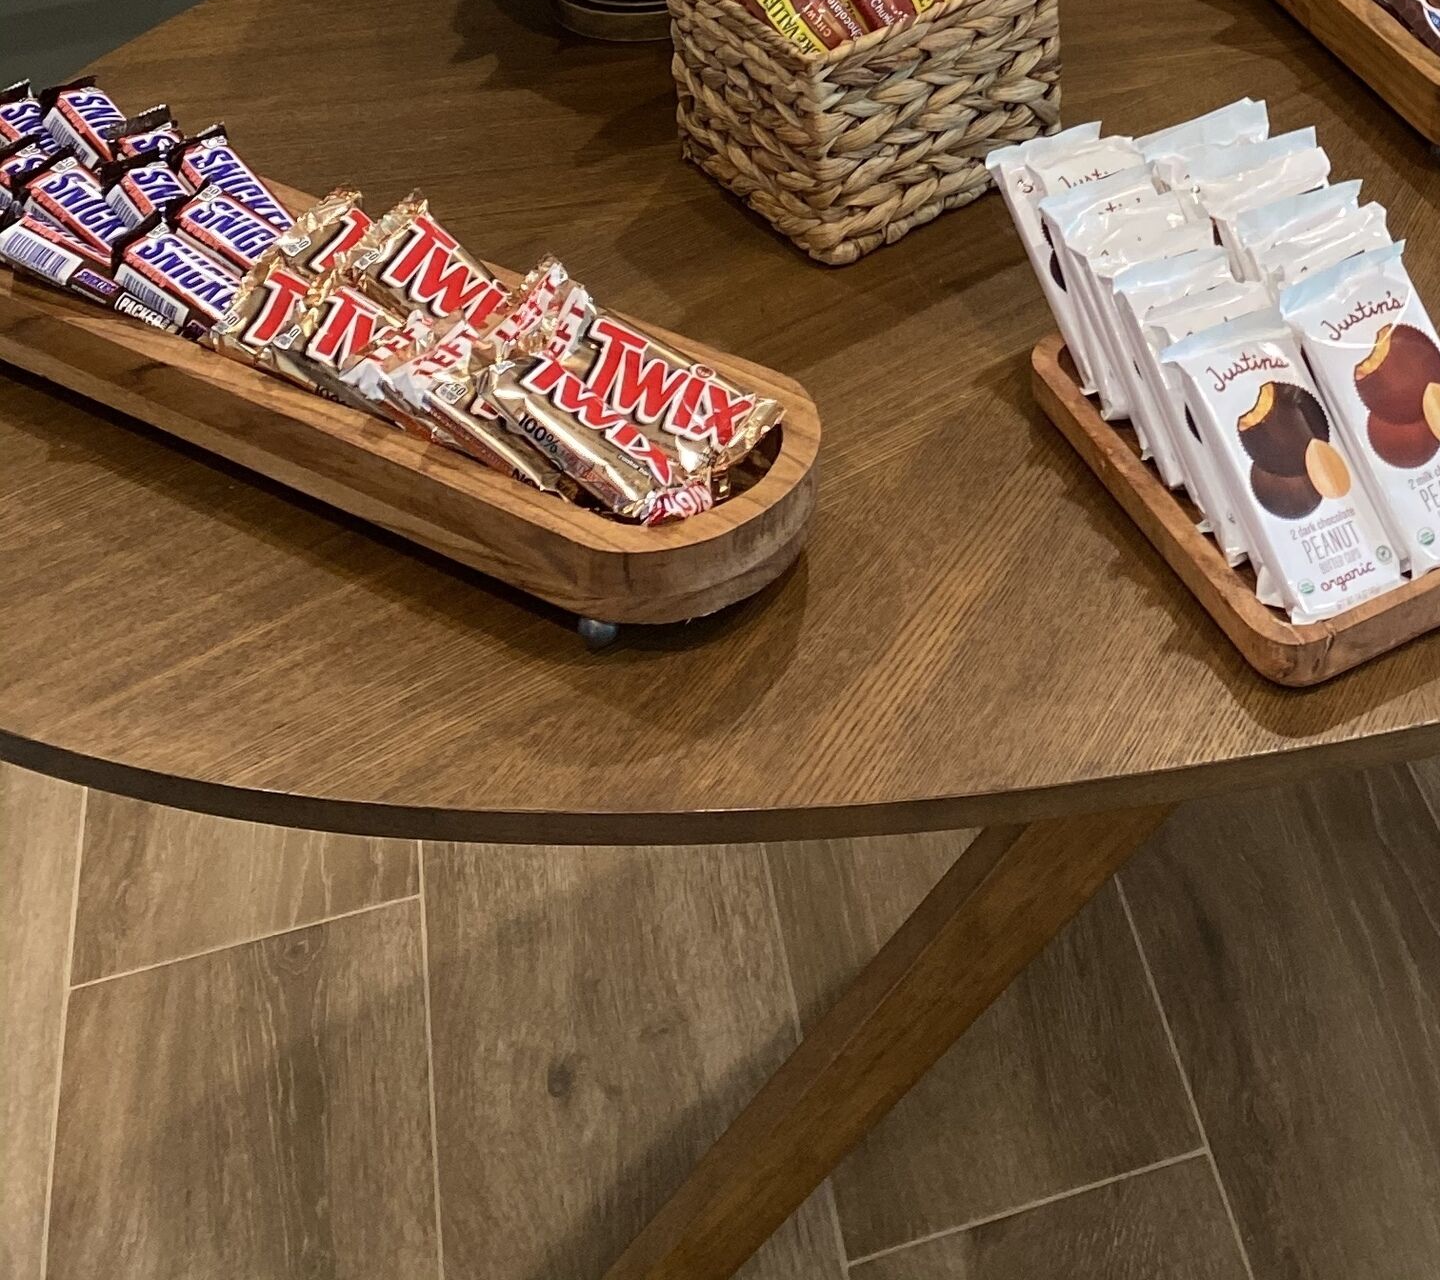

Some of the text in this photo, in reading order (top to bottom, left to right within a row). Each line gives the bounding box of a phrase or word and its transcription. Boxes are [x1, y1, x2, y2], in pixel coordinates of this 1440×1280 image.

[381, 215, 509, 328] TWI
[1320, 290, 1405, 342] Justin's
[589, 318, 756, 450] TWIX
[1206, 352, 1290, 392] Justins
[518, 414, 558, 453] 100%
[521, 356, 672, 486] TWIX
[1298, 508, 1356, 538] dark chocolate
[1302, 521, 1361, 564] PEANUT
[1320, 562, 1377, 593] organic
